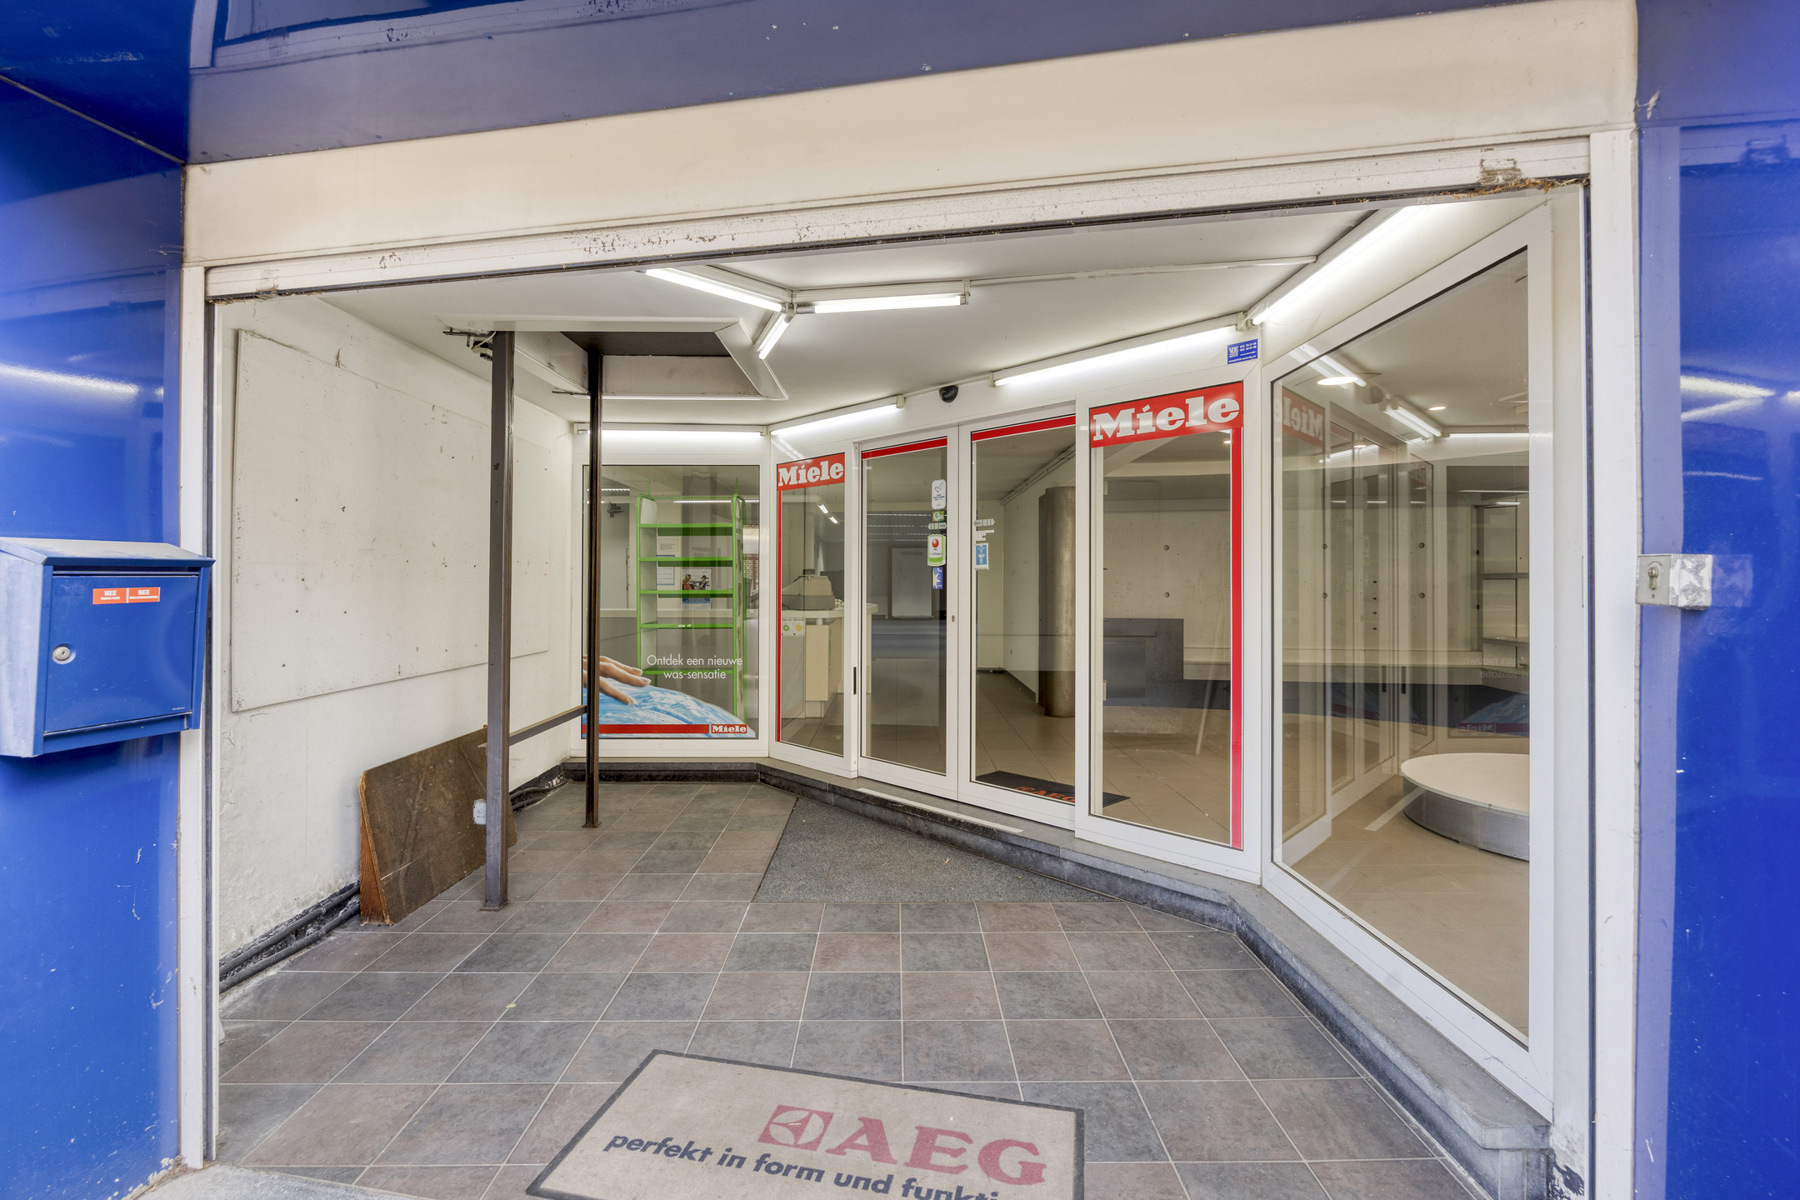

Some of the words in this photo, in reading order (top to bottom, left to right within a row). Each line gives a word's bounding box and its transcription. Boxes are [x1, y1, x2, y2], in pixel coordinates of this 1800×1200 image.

[1093, 396, 1240, 441] Miele
[778, 460, 844, 486] Miele
[646, 653, 684, 666] Ontdek
[686, 657, 704, 666] een
[707, 655, 743, 666] nieuwe
[663, 668, 727, 679] was-sensatie
[711, 725, 747, 733] Miele
[825, 1116, 1047, 1185] AEG
[602, 1135, 713, 1162] perfekt
[716, 1147, 747, 1169] in
[753, 1153, 825, 1183] form
[833, 1173, 894, 1195] und
